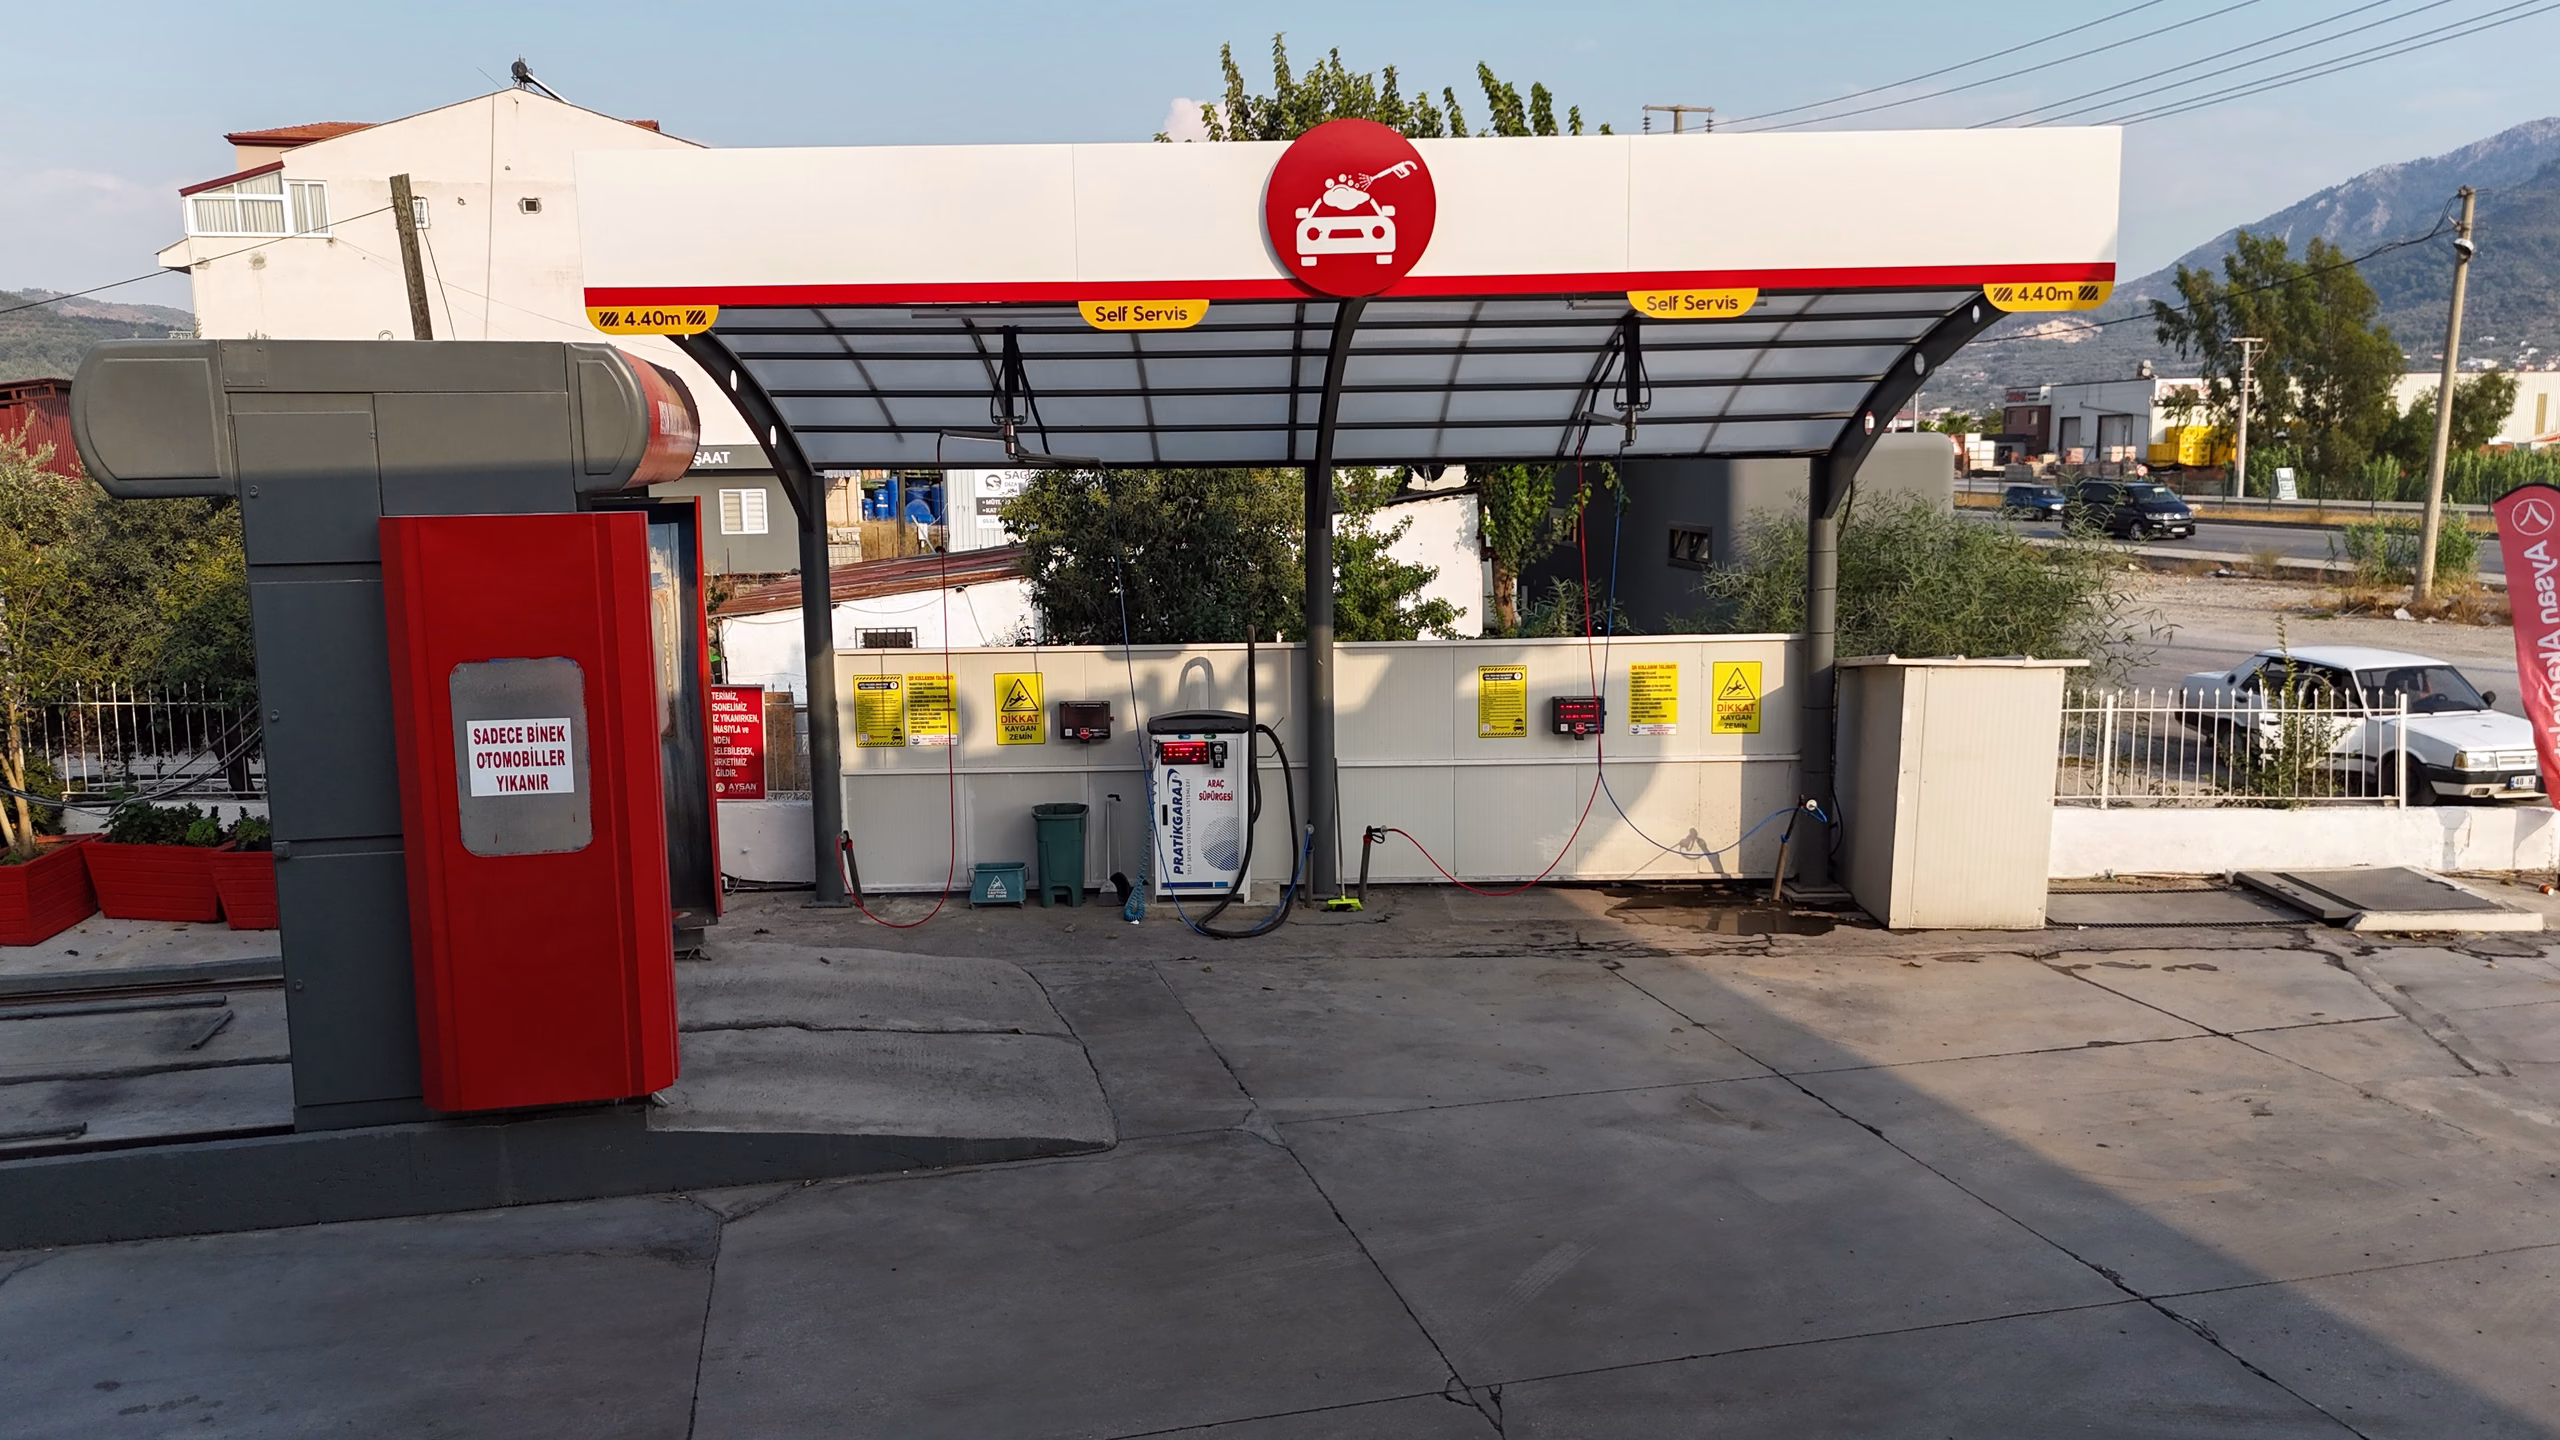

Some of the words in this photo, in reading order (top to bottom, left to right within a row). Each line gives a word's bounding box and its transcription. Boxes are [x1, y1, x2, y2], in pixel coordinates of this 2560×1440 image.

[2017, 286, 2073, 302] 4.40m
[1647, 295, 1679, 311] Self
[1684, 294, 1738, 311] Servis
[624, 310, 681, 326] 4.40m
[1095, 306, 1128, 322] Self
[1133, 305, 1188, 322] Servis
[1717, 702, 1756, 712] DİKKAT
[720, 713, 759, 724] YIKANIRKEN,
[1000, 713, 1039, 724] DİKKAT
[473, 727, 523, 745] SADECE
[527, 722, 566, 743] BİNEK
[1009, 733, 1033, 741] ZEMİN
[476, 746, 566, 769] OTOMOBİLLER
[715, 766, 738, 777] ĞİLDİR.
[496, 773, 549, 792] YIKANIR
[1207, 779, 1225, 789] ARAÇ
[1199, 790, 1233, 801] SÜPÜRGESİ
[1169, 778, 1184, 875] PRATİKGARAJ
